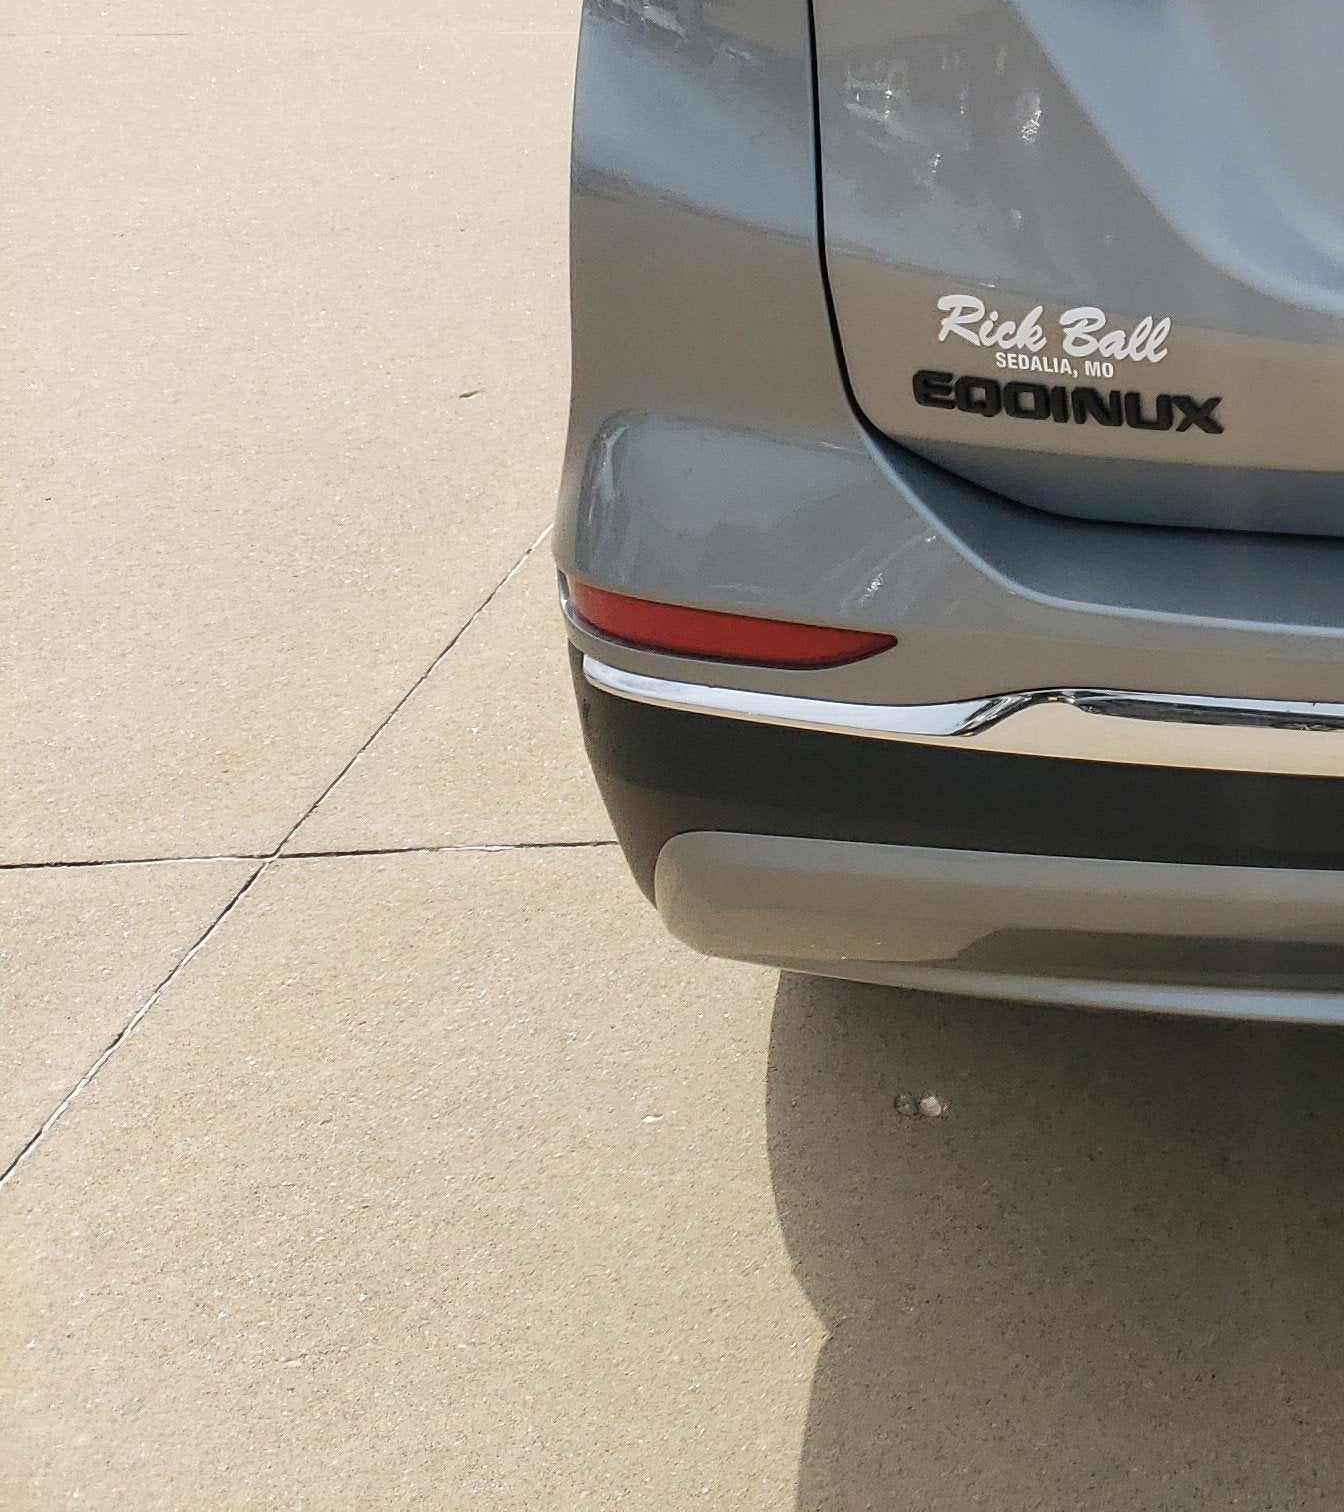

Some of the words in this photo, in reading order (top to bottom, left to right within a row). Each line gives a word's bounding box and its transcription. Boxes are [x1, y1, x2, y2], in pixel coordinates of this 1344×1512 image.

[937, 293, 1048, 353] Rick
[1059, 306, 1173, 364] Ball
[994, 352, 1079, 379] SEDALIA,
[1084, 359, 1115, 379] MO
